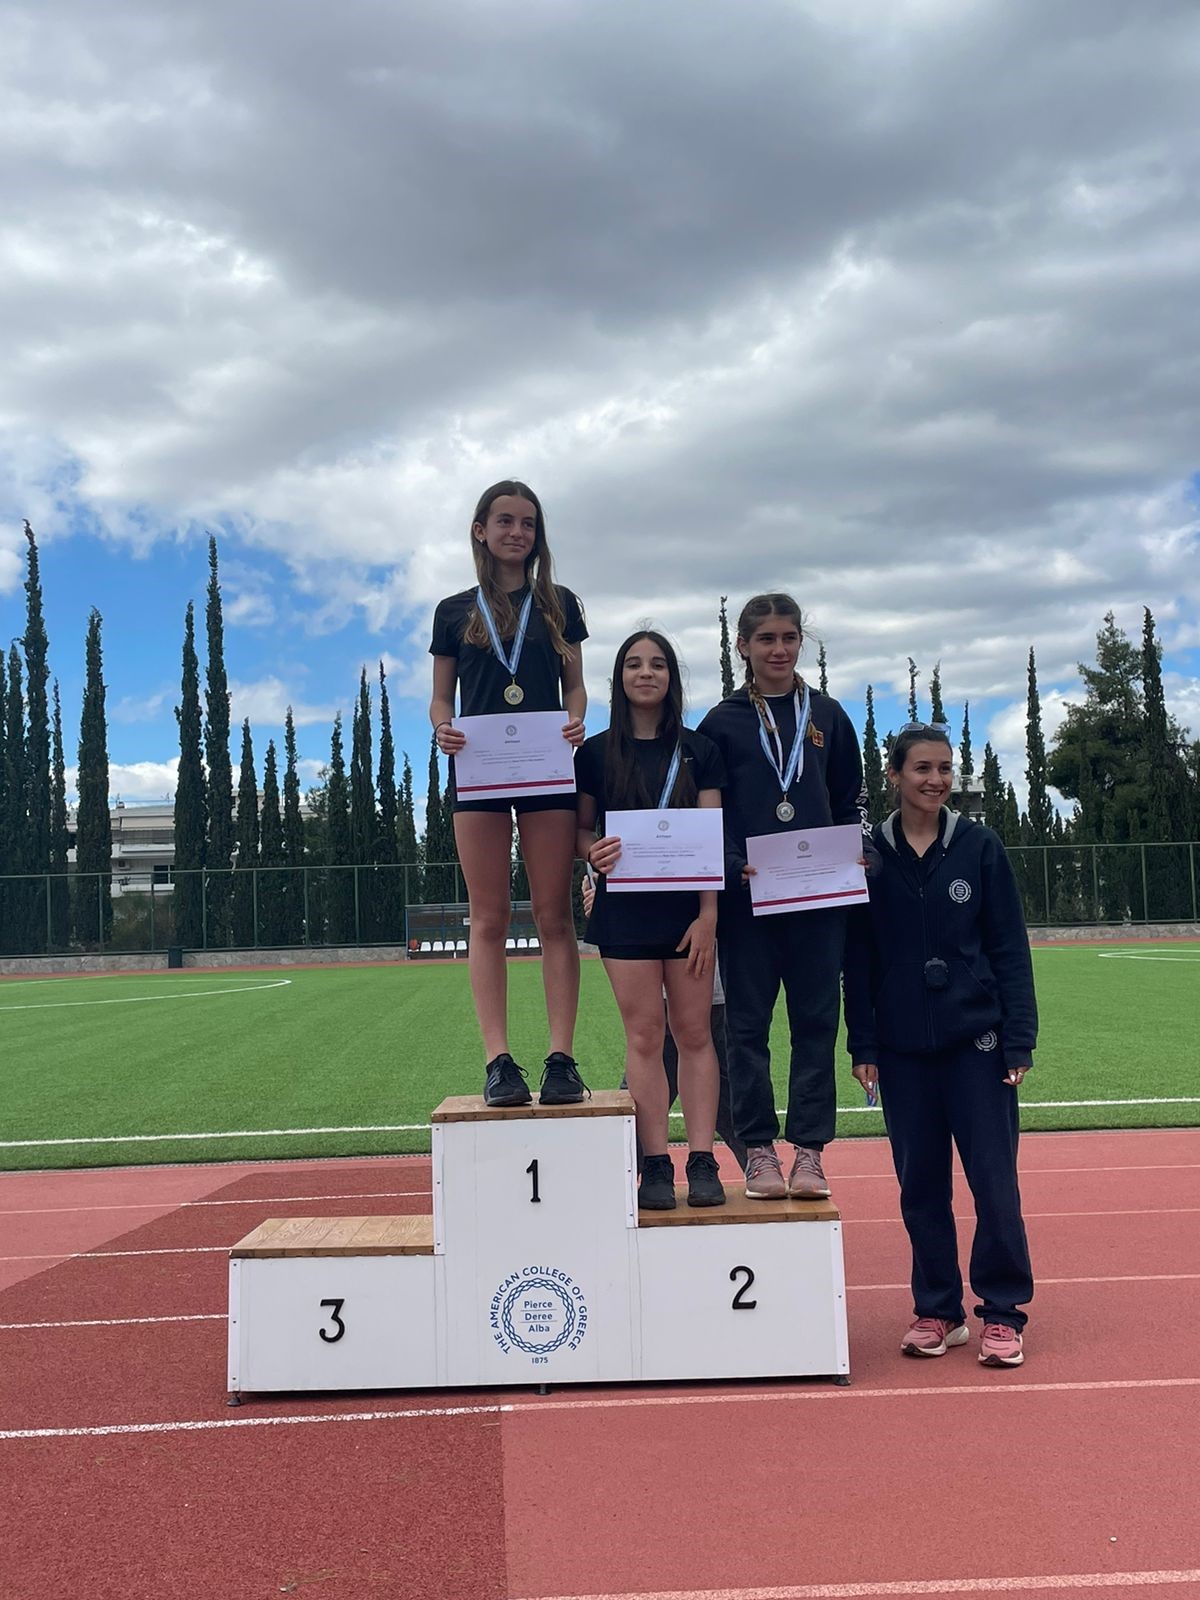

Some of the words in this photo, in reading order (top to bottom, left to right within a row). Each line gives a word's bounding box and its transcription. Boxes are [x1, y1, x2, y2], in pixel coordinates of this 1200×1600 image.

[525, 1159, 541, 1203] 1
[522, 1266, 573, 1287] COLLEGE
[571, 1286, 585, 1302] OF
[729, 1265, 757, 1311] 2
[490, 1272, 520, 1329] AMERICAN
[523, 1300, 553, 1309] Pierce
[318, 1298, 346, 1344] 3
[524, 1312, 553, 1321] Deree
[528, 1324, 550, 1333] Alba
[567, 1305, 588, 1351] GREECE
[494, 1332, 511, 1354] THE
